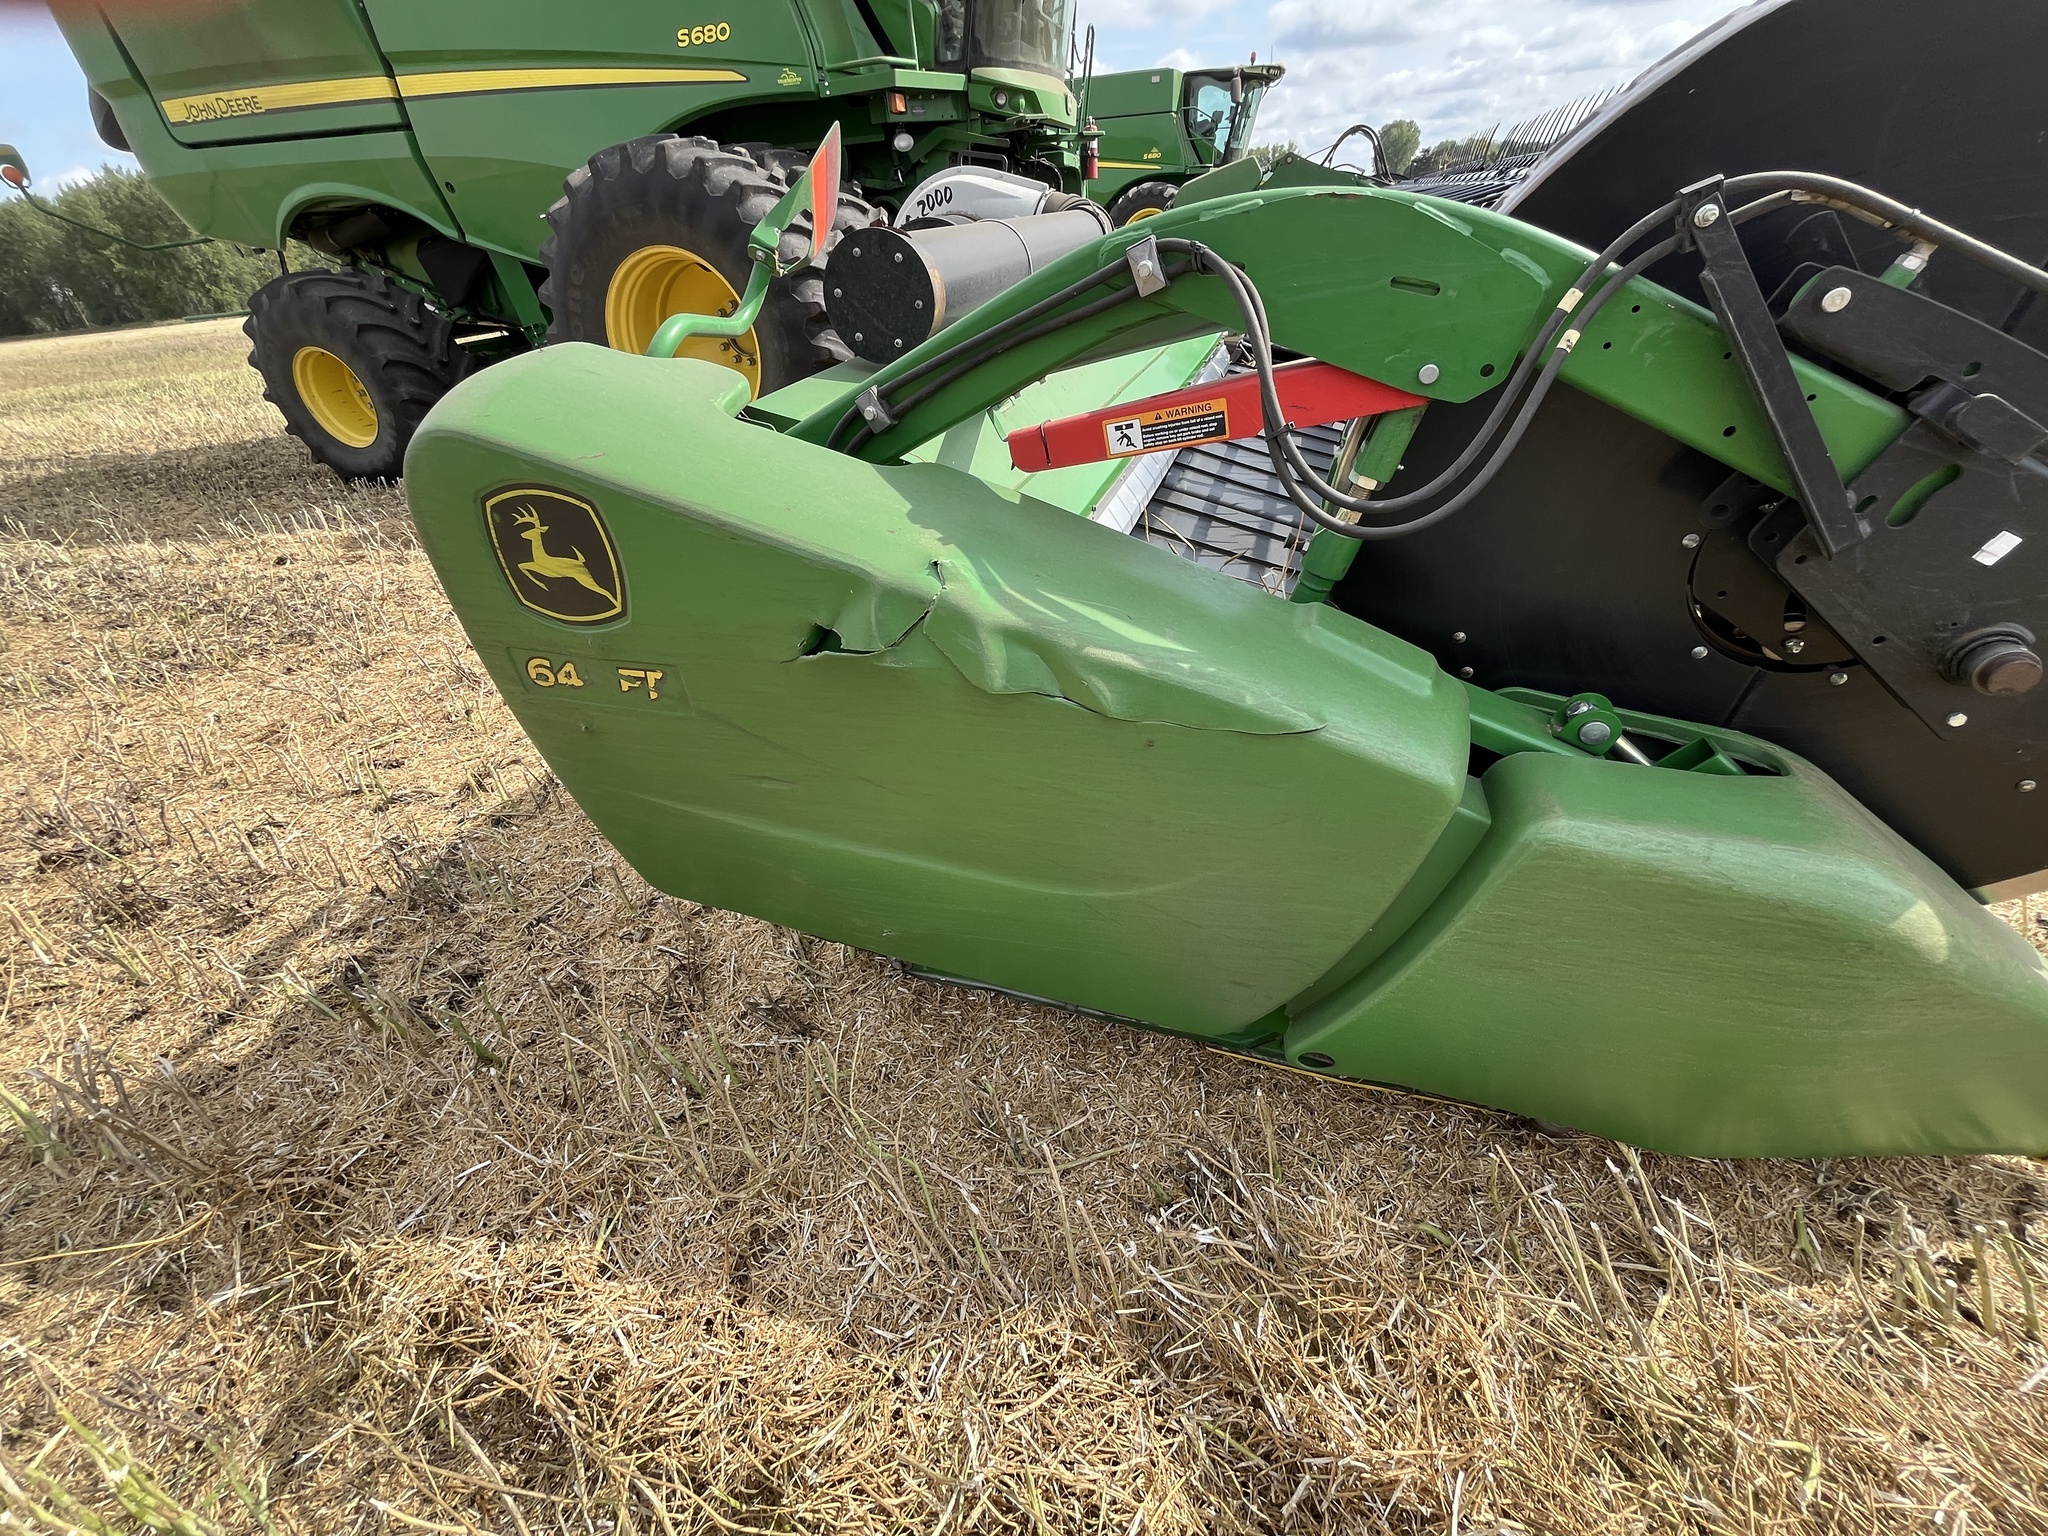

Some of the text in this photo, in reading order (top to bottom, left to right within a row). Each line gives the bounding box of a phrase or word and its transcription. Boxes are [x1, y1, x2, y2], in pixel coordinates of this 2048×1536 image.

[677, 21, 731, 48] S680
[916, 185, 953, 217] 2000
[1165, 403, 1212, 418] WARNING
[526, 656, 585, 688] 64
